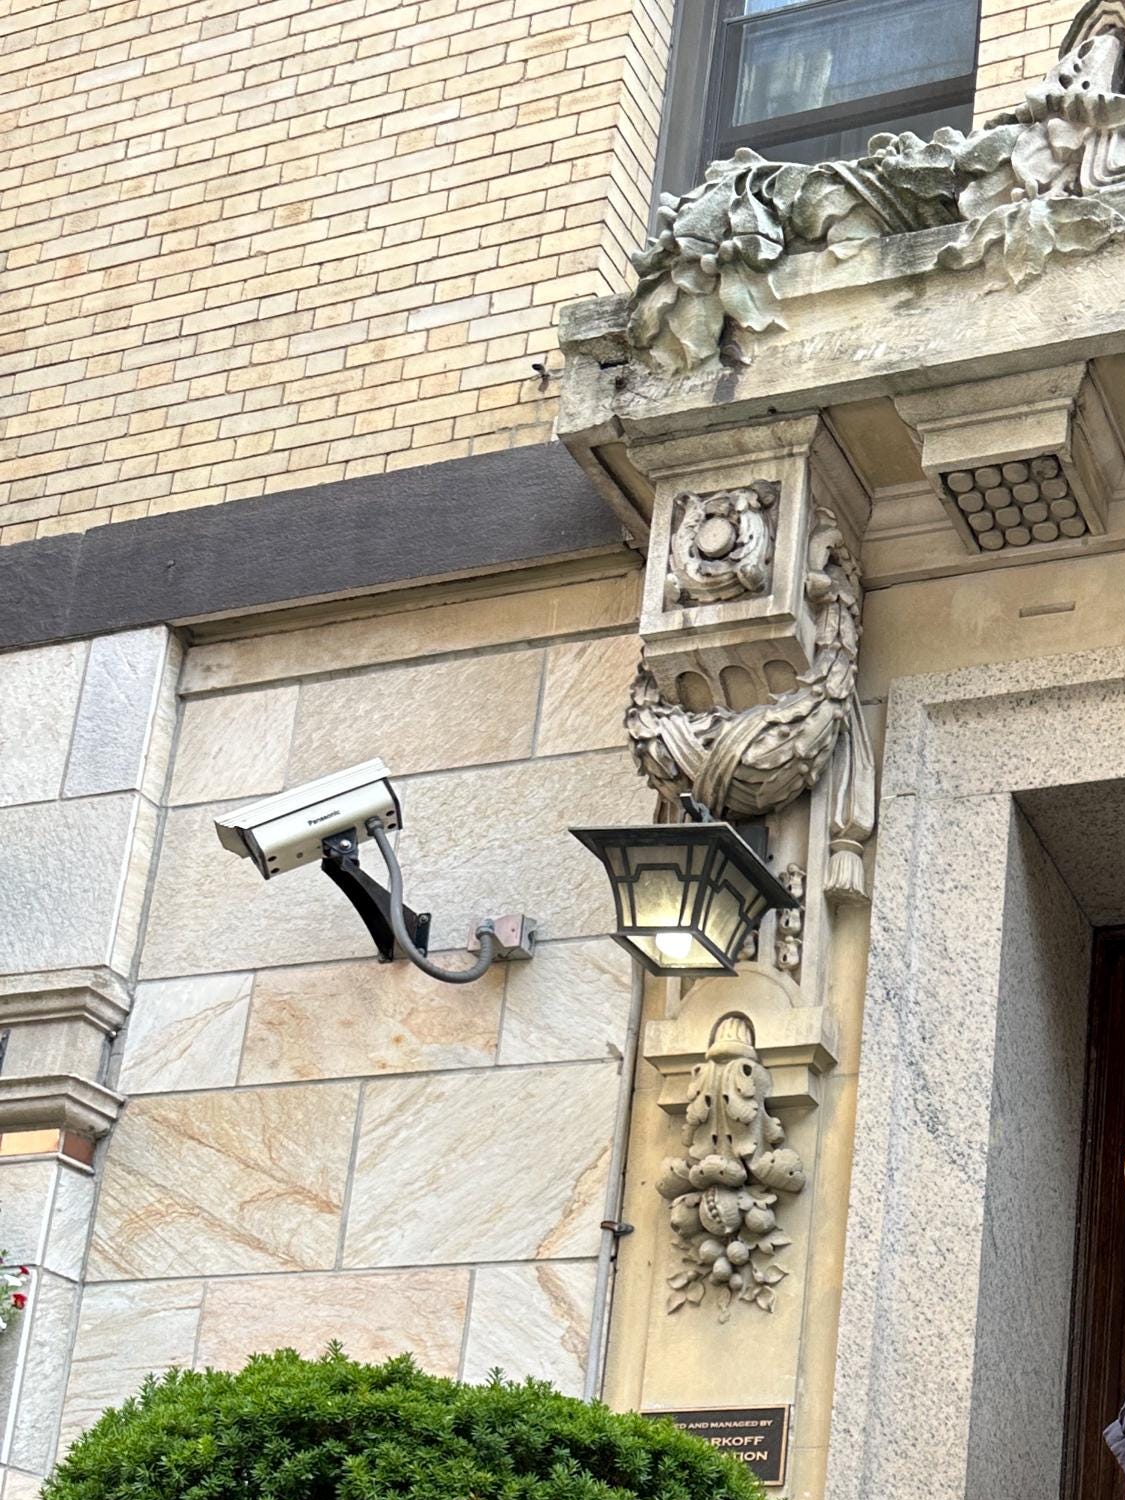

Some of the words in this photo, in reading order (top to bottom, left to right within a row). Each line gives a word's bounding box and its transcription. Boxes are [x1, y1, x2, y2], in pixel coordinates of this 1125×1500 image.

[307, 810, 341, 826] Panasonic
[688, 1421, 709, 1430] AND
[710, 1420, 759, 1429] MANAGED
[760, 1419, 774, 1428] BY
[704, 1435, 766, 1447] RKOFF
